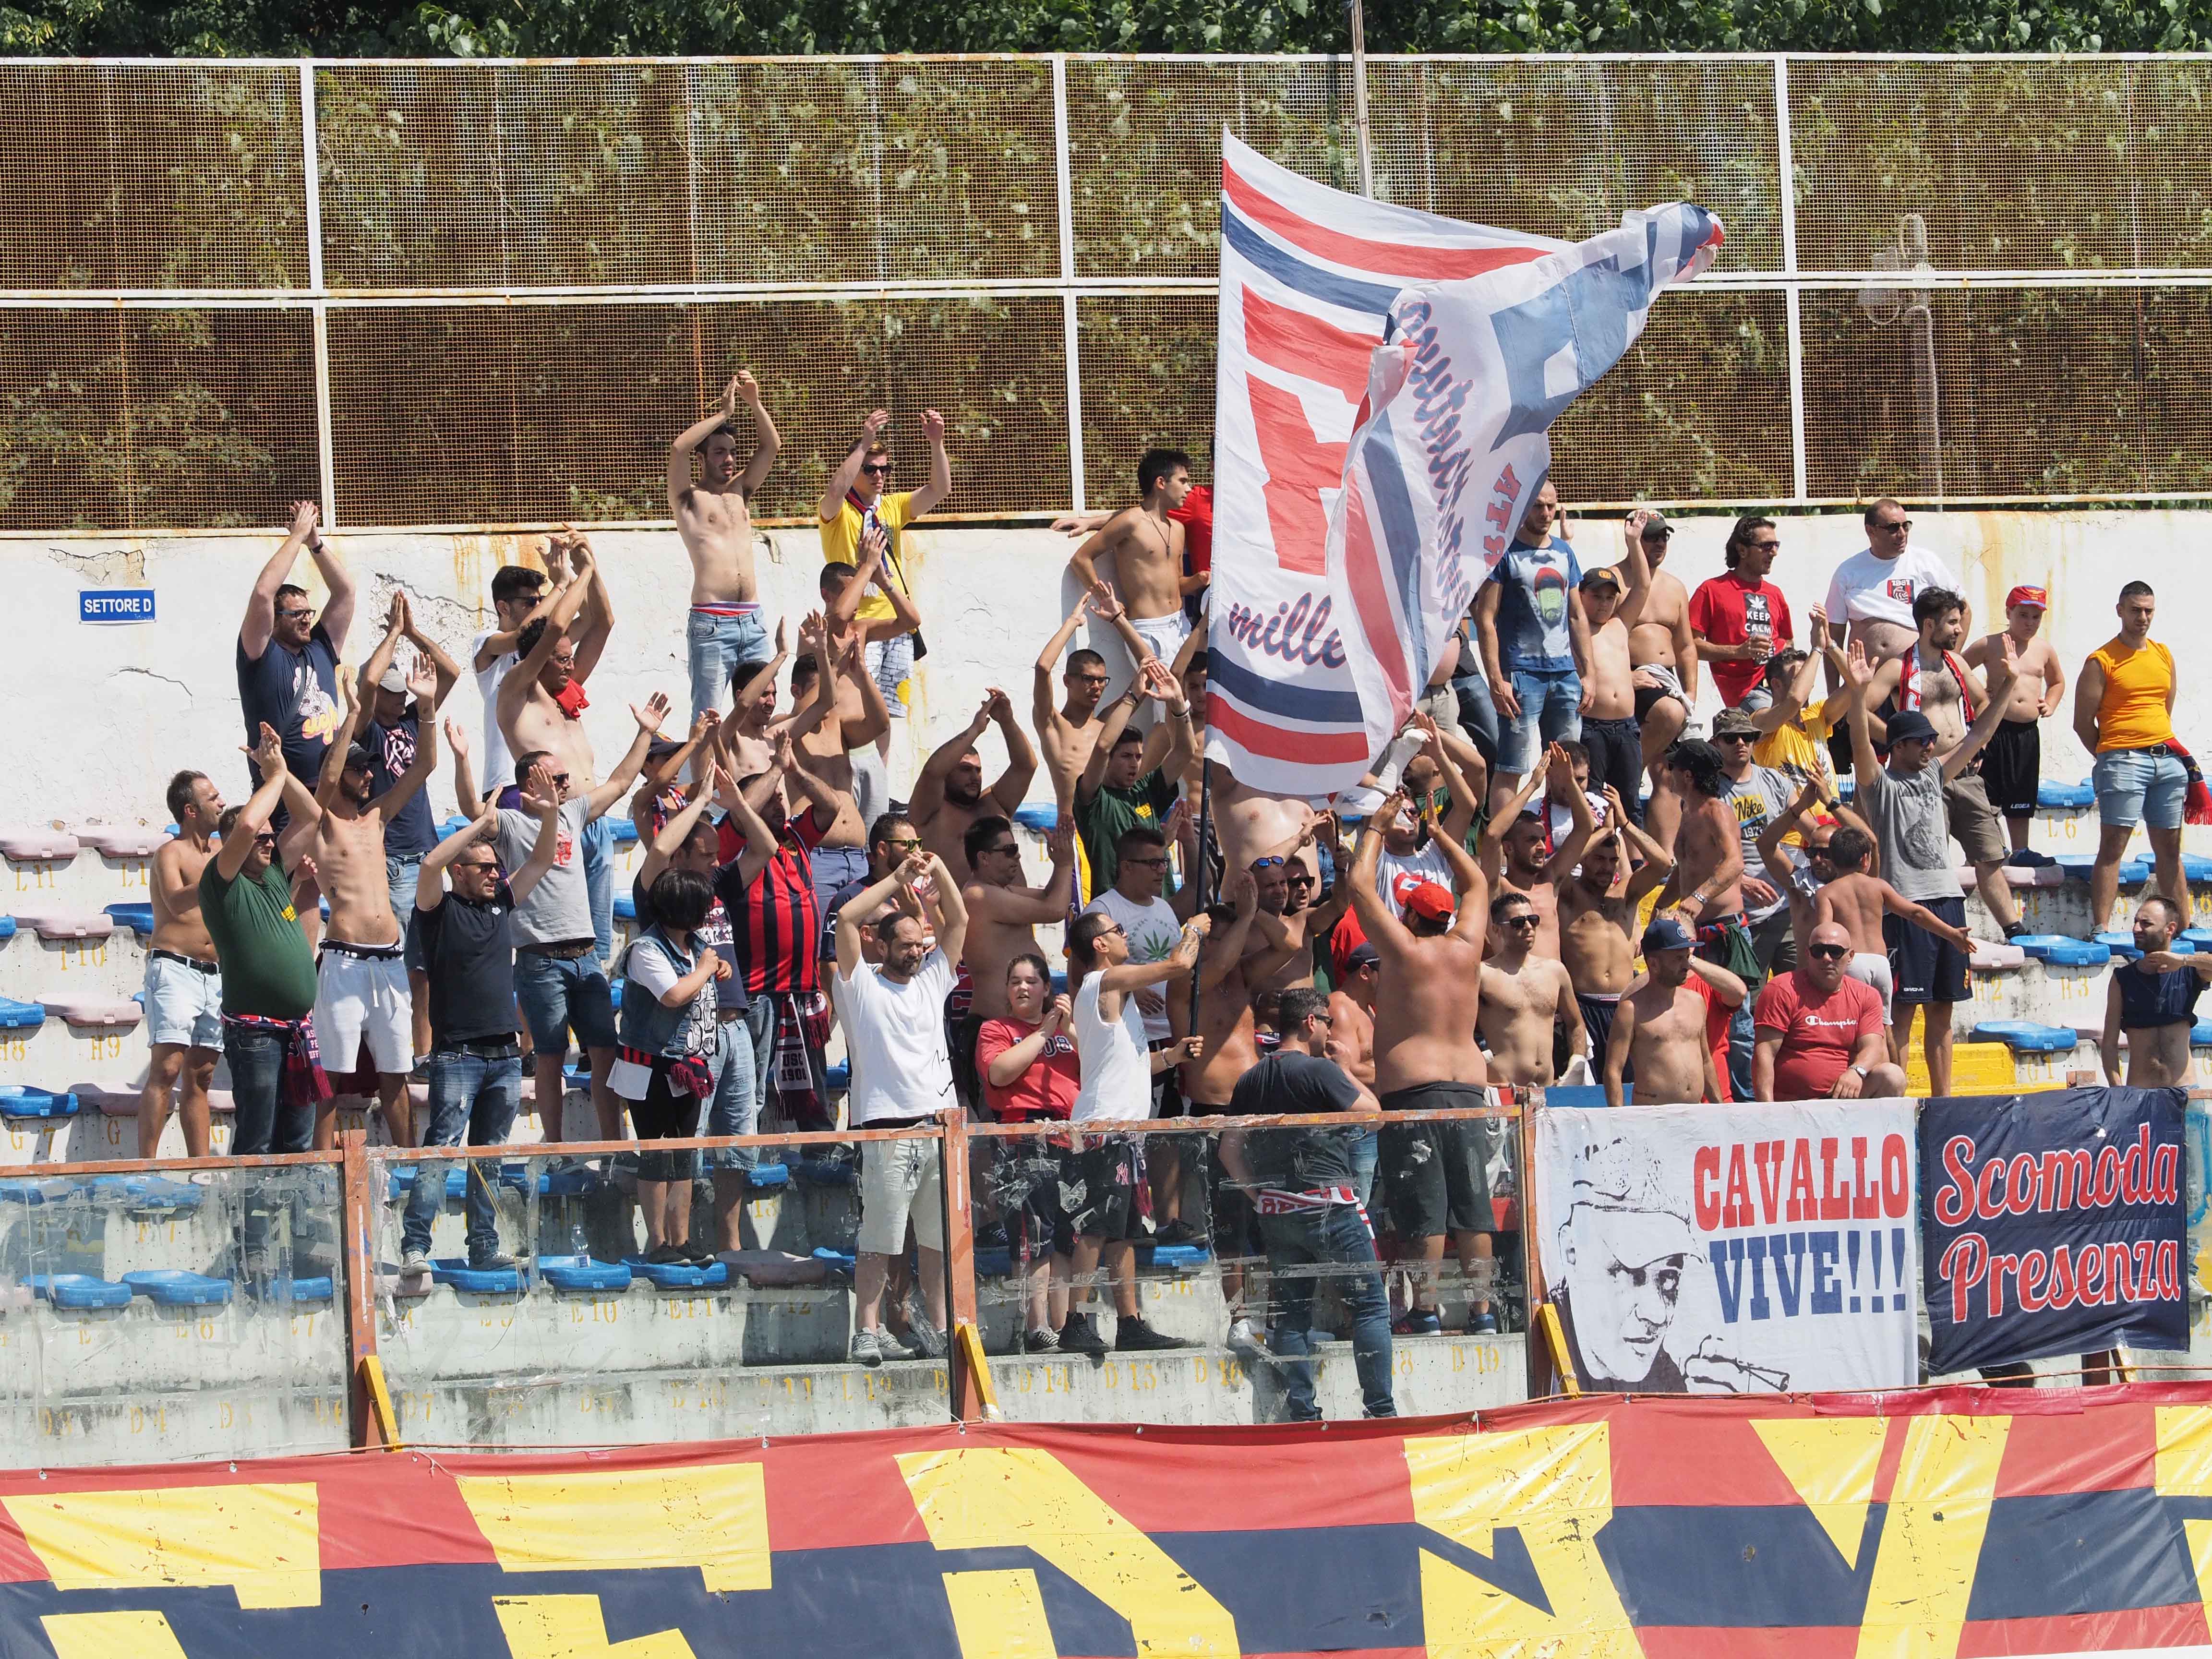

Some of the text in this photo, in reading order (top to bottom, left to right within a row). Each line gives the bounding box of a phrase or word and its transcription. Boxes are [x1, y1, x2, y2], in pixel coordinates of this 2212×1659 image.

[84, 598, 152, 613] SETTORE D
[1746, 610, 1770, 622] KEEP
[1744, 623, 1772, 634] CALM
[1735, 798, 1764, 822] Nike
[1805, 1015, 1859, 1030] Champio
[1694, 1133, 1909, 1232] CAVALLO
[1934, 1121, 2179, 1227] Scomoda
[1709, 1227, 1907, 1323] VIVE!!!
[1939, 1232, 2181, 1324] Presenza
